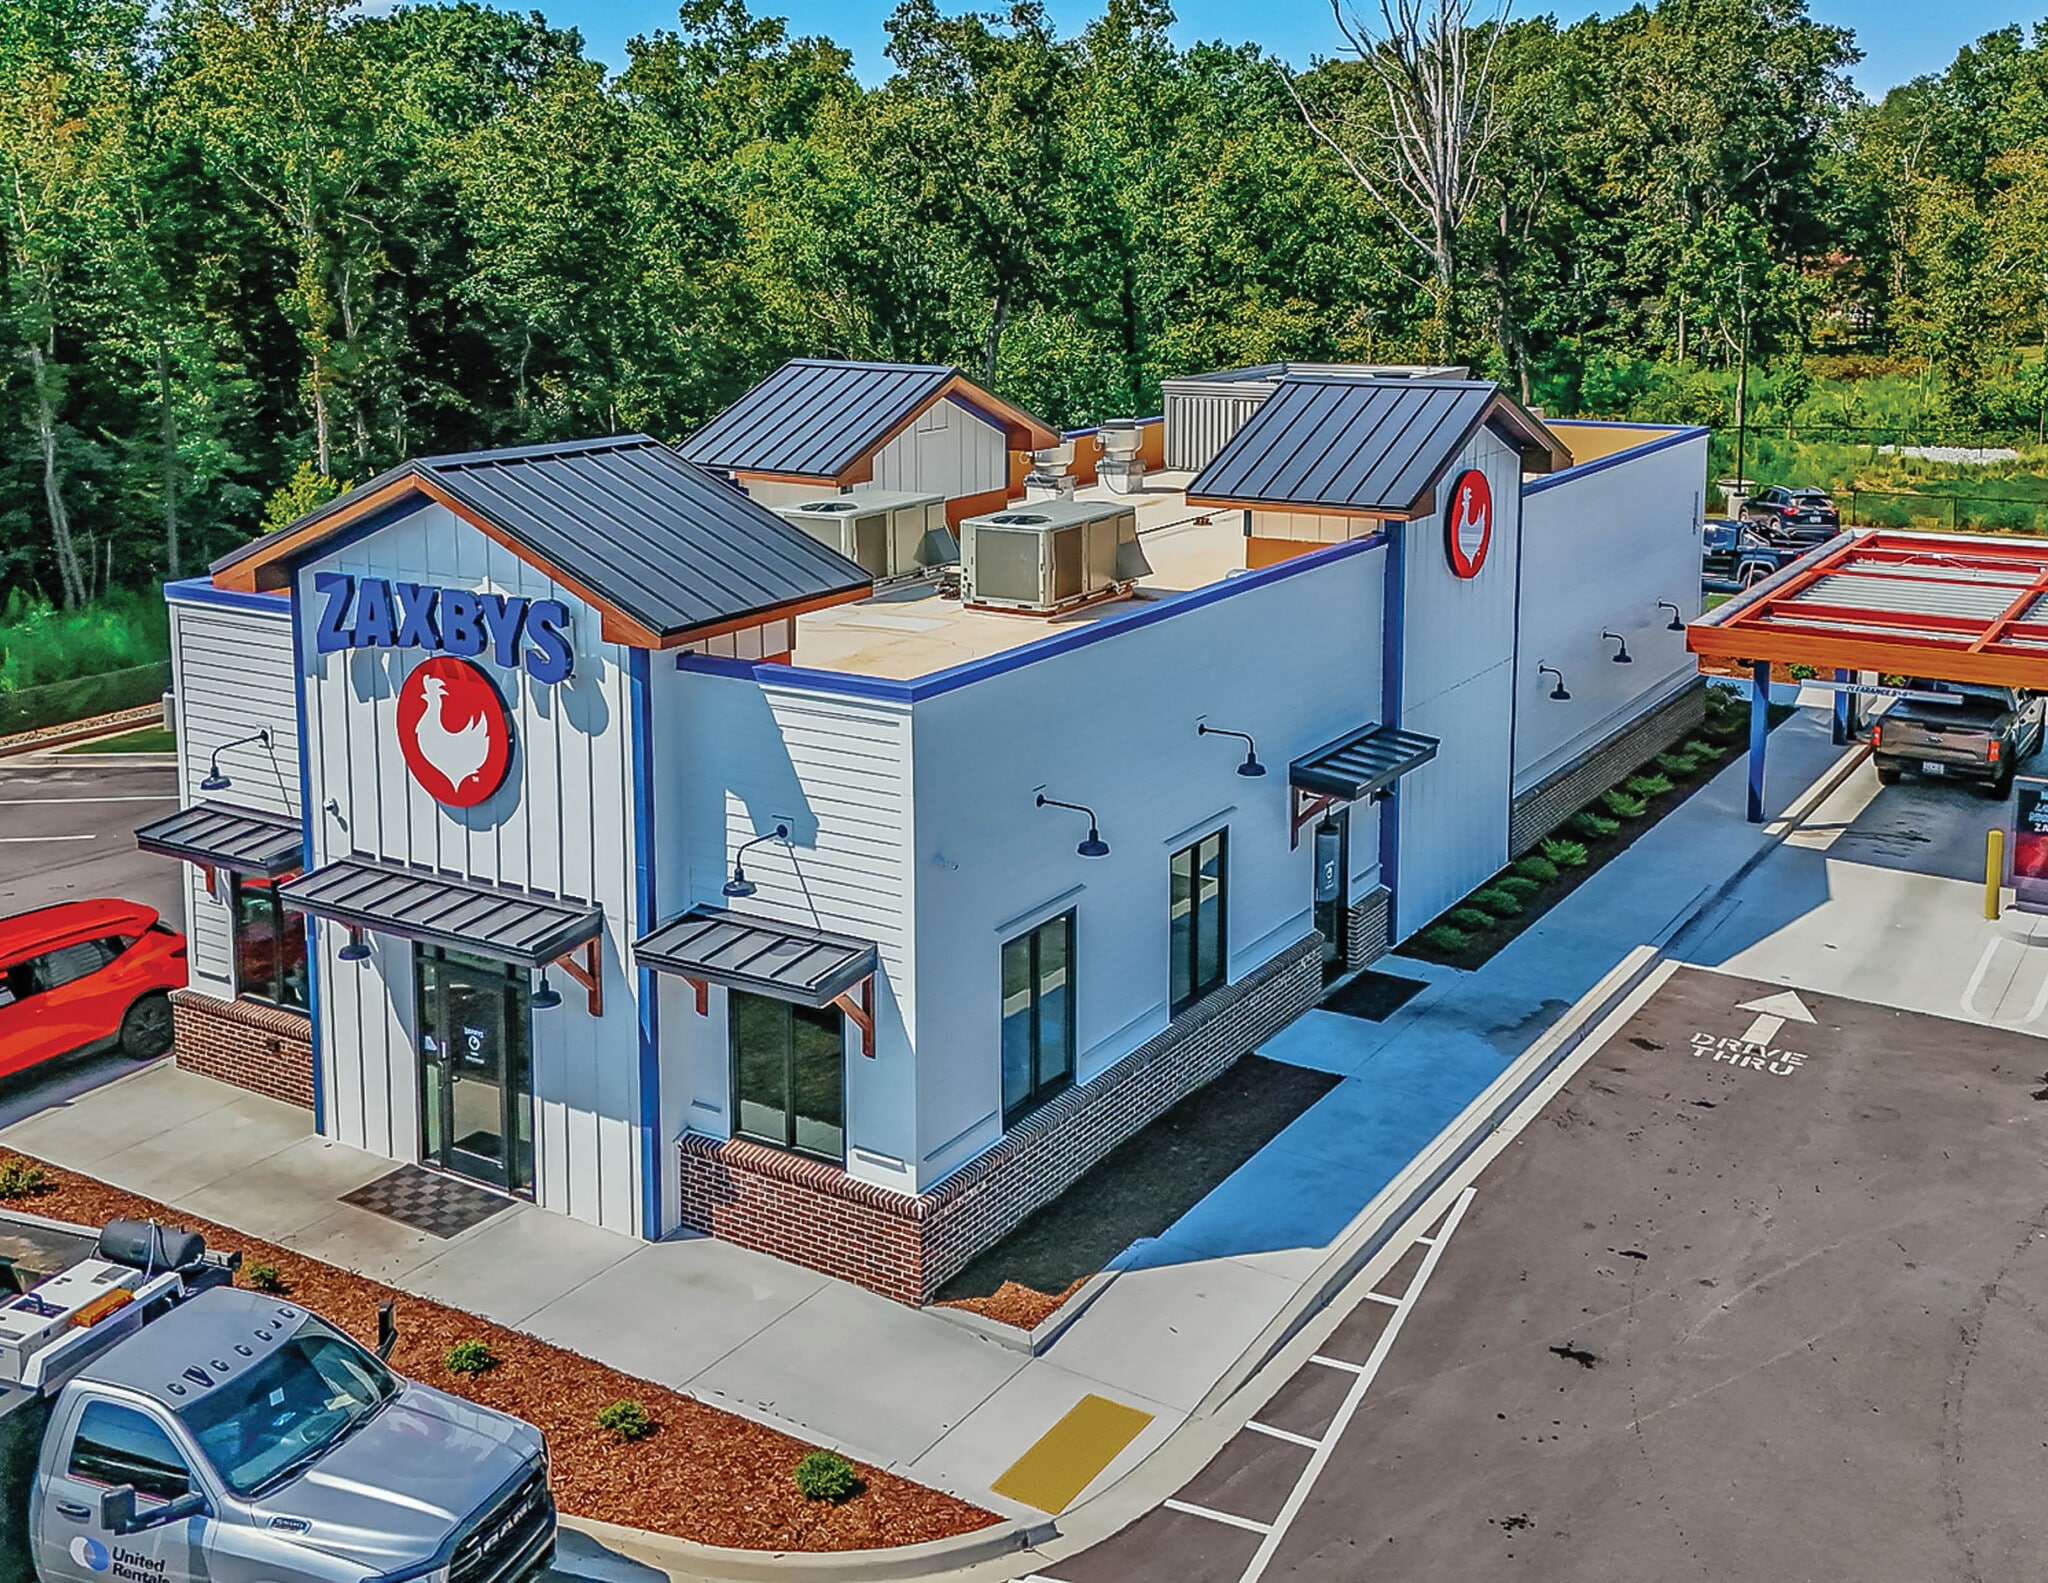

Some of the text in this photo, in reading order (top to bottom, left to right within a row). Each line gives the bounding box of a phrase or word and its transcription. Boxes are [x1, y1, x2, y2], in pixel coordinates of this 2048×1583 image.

[315, 572, 574, 684] ZAXBYS
[1846, 685, 1890, 696] CLEARANCE
[1690, 1032, 1808, 1066] DRIVE
[1692, 1044, 1794, 1075] THRU
[113, 1546, 165, 1573] United
